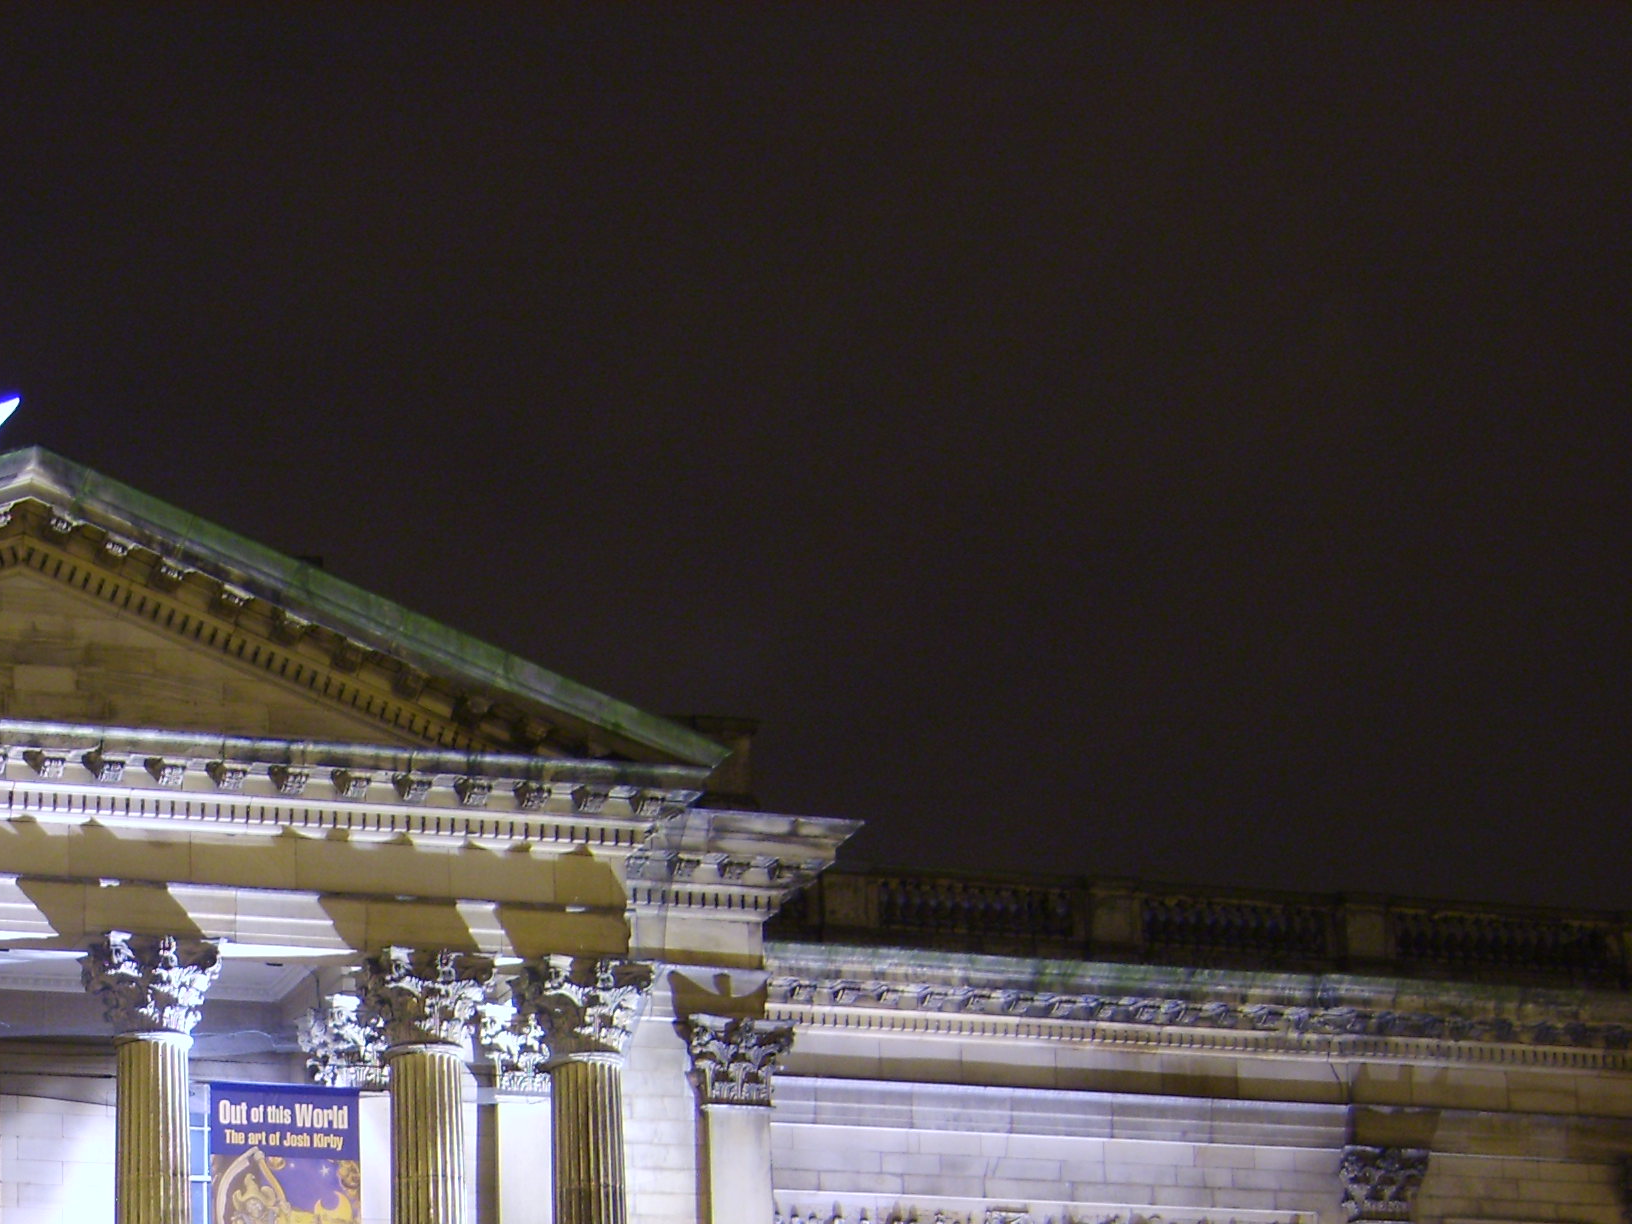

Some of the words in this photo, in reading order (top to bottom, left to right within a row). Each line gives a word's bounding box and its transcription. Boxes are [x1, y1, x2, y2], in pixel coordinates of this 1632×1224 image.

[219, 1099, 248, 1125] Out
[250, 1104, 264, 1123] of
[266, 1105, 292, 1124] this
[294, 1103, 349, 1129] World
[224, 1129, 245, 1144] The
[248, 1131, 267, 1145] art
[269, 1131, 280, 1146] of
[283, 1132, 310, 1147] Josh
[313, 1133, 344, 1151] Kirby
